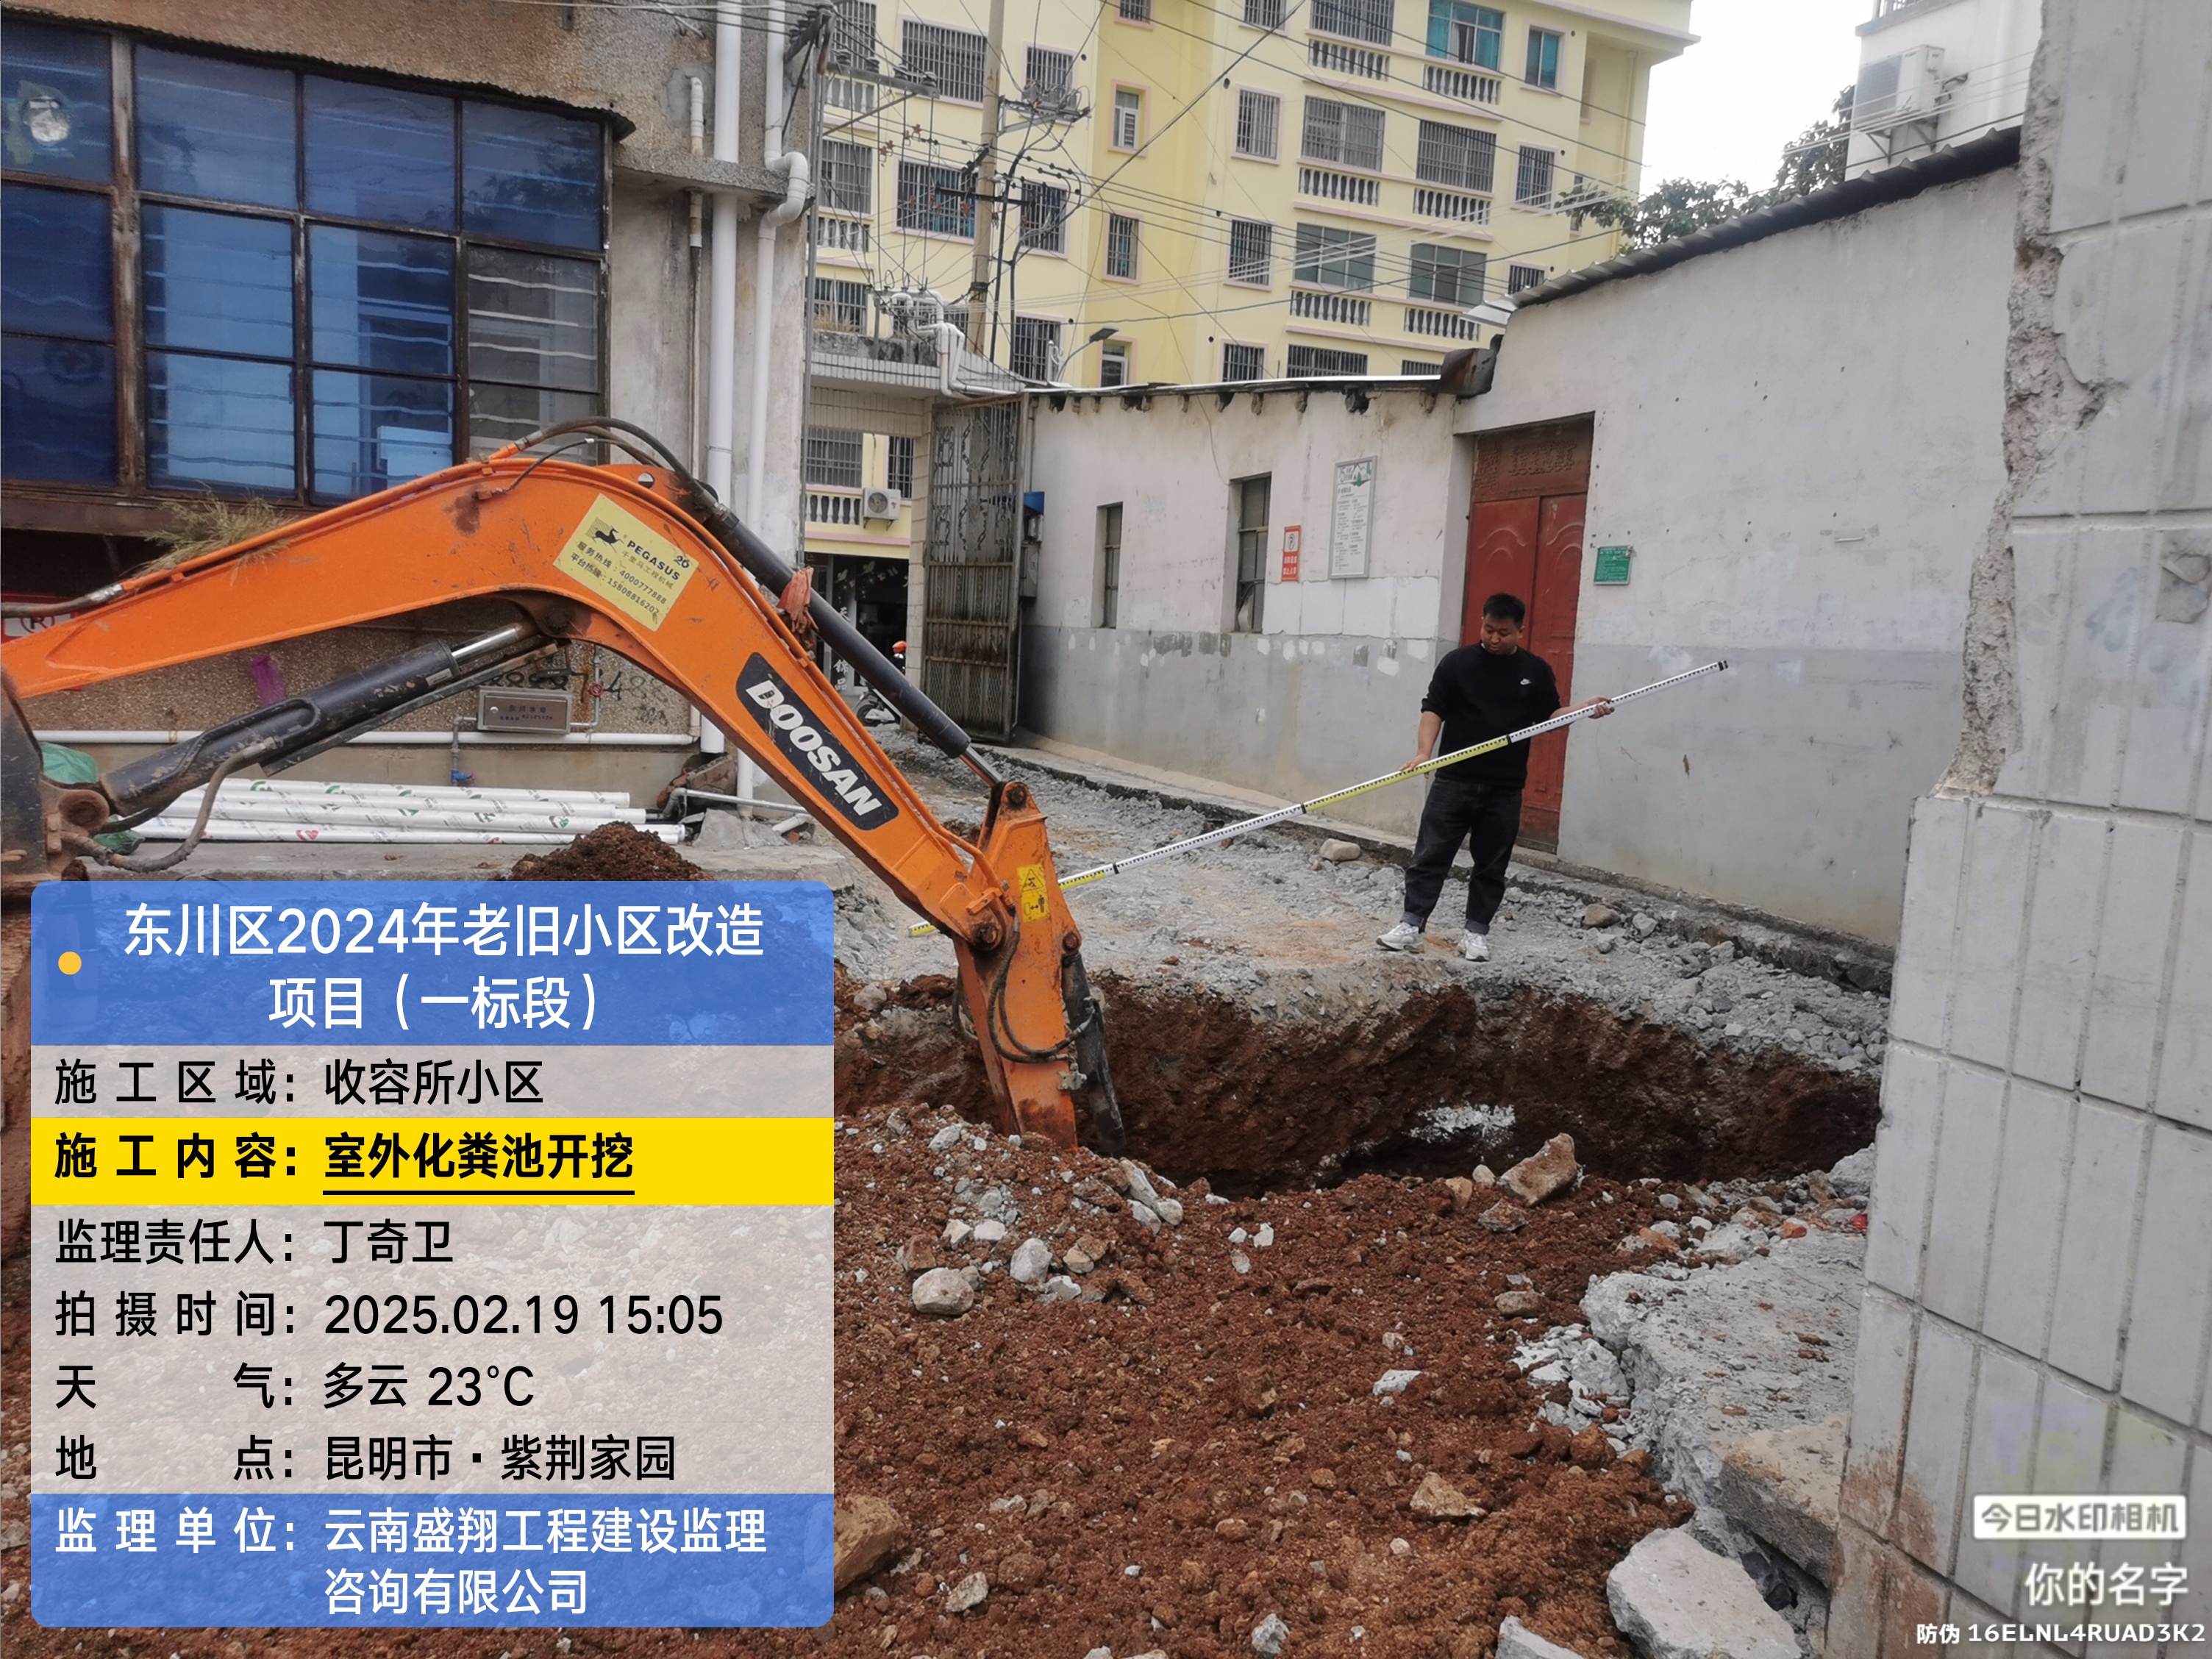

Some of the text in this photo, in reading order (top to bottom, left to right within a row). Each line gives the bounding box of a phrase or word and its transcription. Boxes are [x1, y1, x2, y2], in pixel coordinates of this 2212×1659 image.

[622, 550, 674, 590] 千里马工程机械
[627, 540, 680, 580] PEGASUS
[619, 569, 667, 605] 4000777888
[745, 679, 882, 816] DOOSAN
